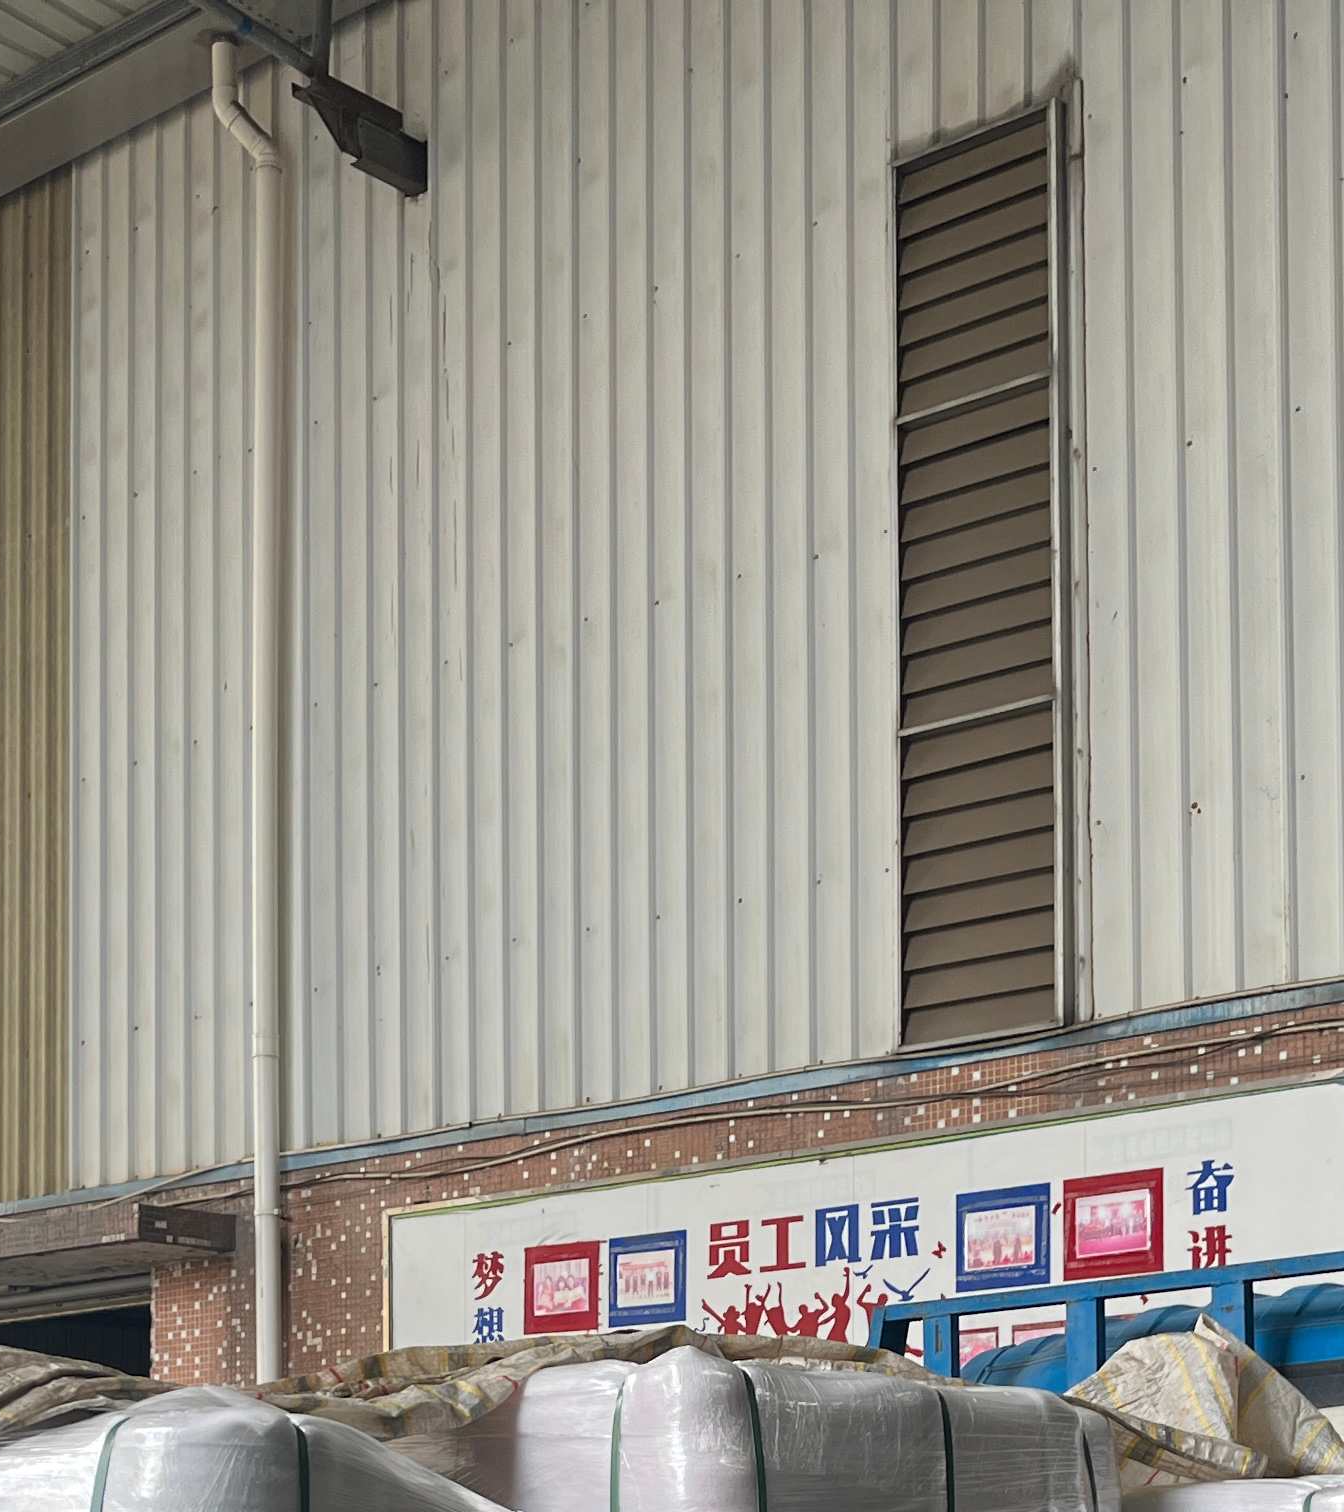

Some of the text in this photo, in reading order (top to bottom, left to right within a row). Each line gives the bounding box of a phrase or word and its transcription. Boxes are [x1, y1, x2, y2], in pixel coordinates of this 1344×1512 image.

[706, 1196, 920, 1280] 员工风采
[1185, 1159, 1235, 1269] 奋进
[471, 1251, 505, 1344] 梦想
